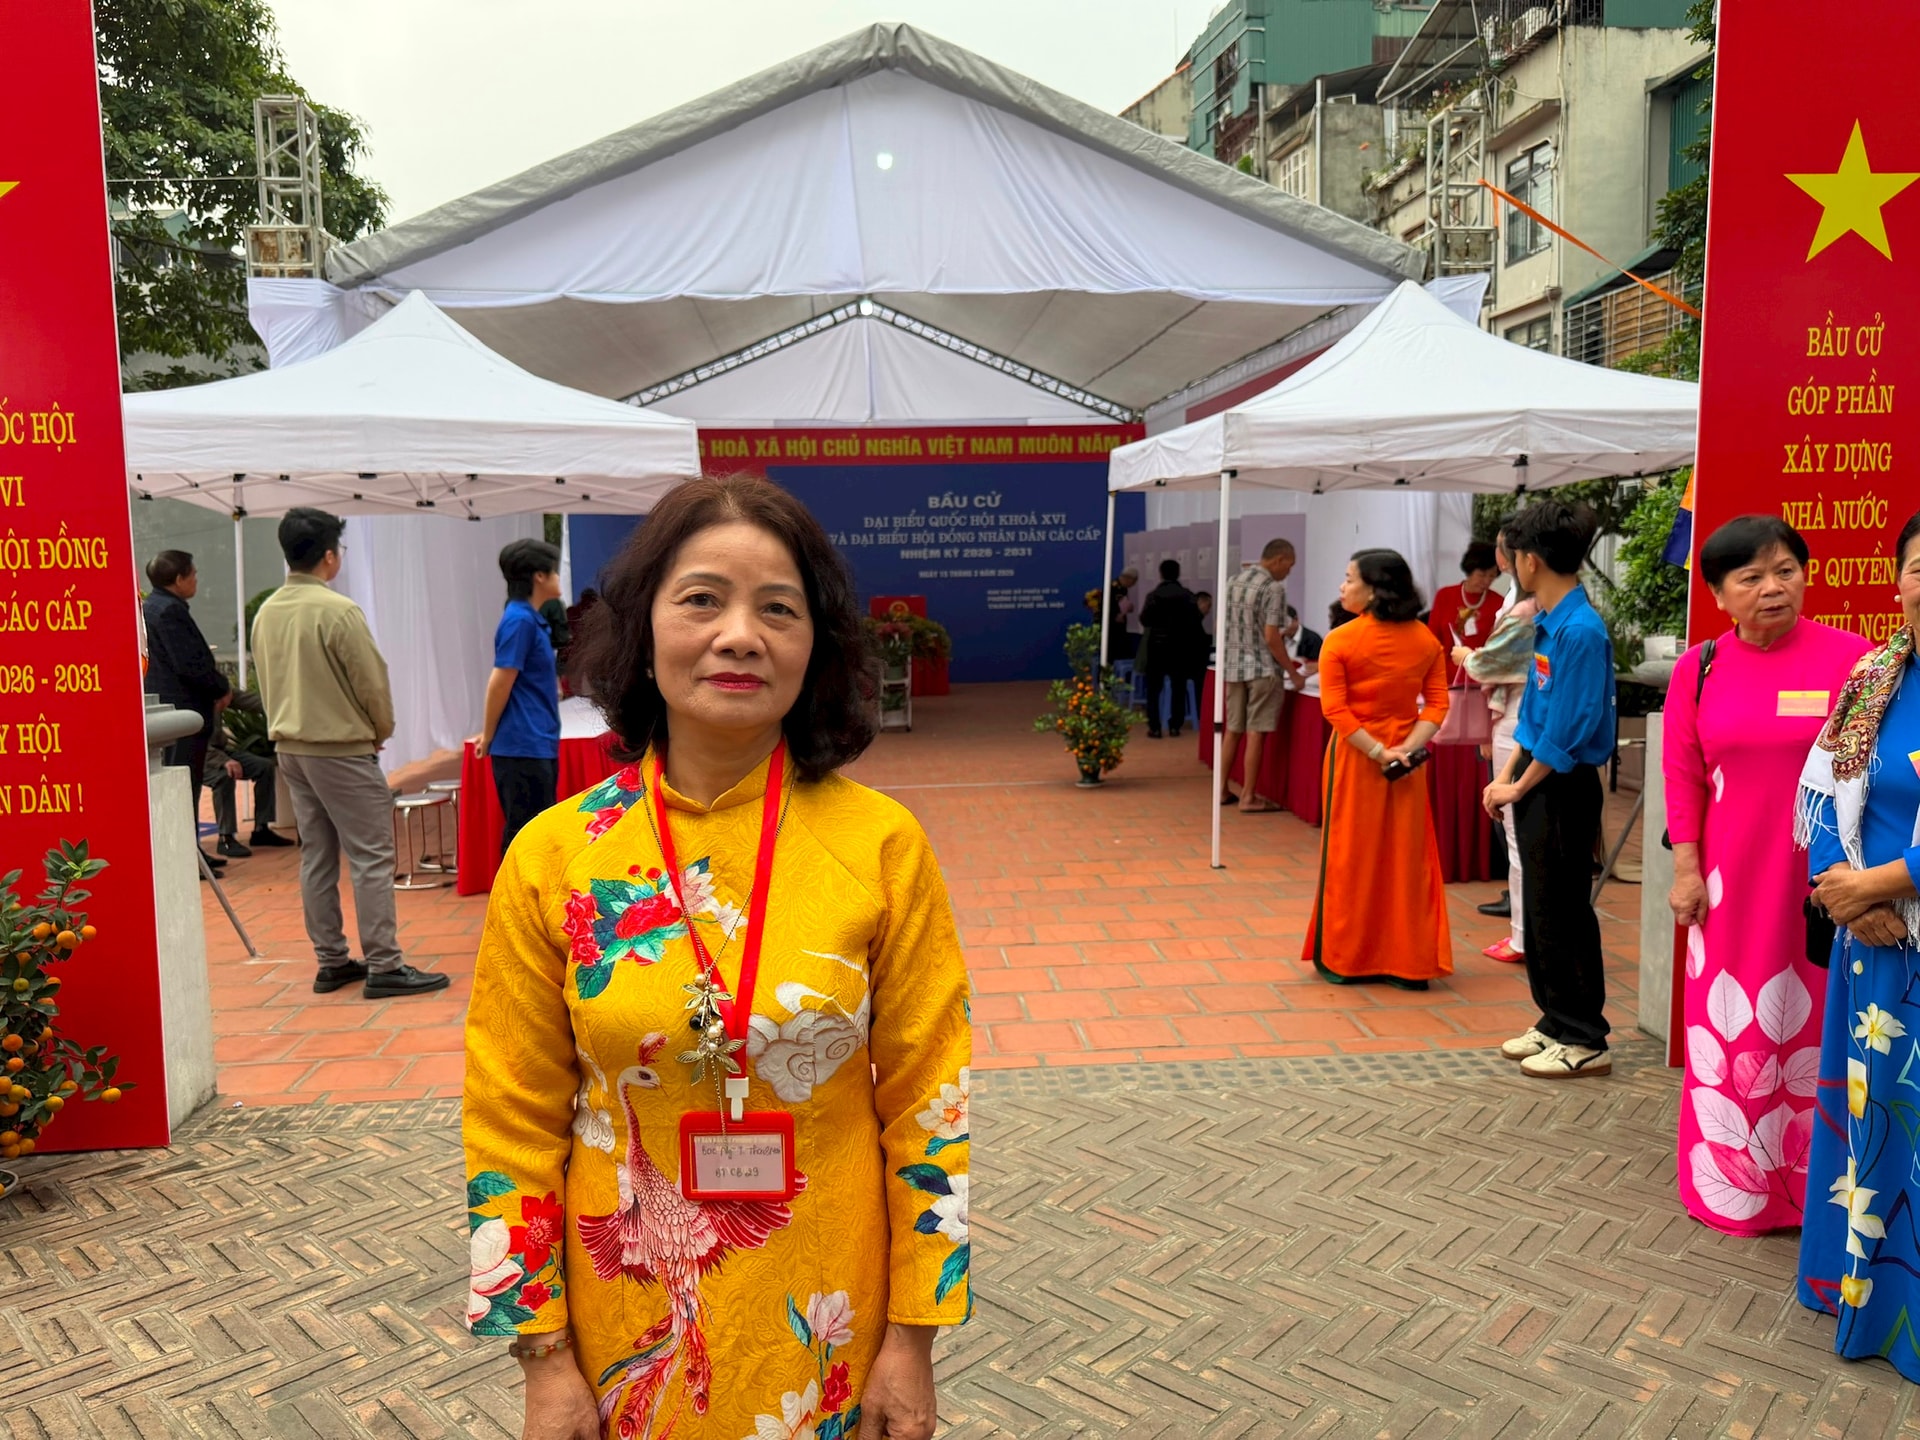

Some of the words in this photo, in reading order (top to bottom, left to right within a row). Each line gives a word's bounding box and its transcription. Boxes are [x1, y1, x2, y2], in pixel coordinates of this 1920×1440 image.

[1806, 310, 1850, 357] BẦU
[1856, 312, 1885, 357] CỬ
[1787, 375, 1831, 416] GÓP
[1835, 367, 1895, 414] PHẦN
[30, 401, 77, 453] HỘI
[711, 436, 749, 457] HOÀ
[755, 435, 780, 457] XÃ
[786, 434, 817, 460] HỘI
[823, 434, 860, 457] CHỦ
[865, 434, 922, 456] NGHĨA
[927, 434, 965, 459] VIỆT
[970, 437, 1013, 455] NAM
[1019, 433, 1073, 454] MUÔN
[1078, 433, 1120, 453] NĂM
[1782, 434, 1829, 474] XÂY
[1834, 438, 1892, 480] DỰNG
[864, 516, 889, 530] ĐẠI
[893, 509, 925, 528] BIỂU
[928, 510, 966, 528] QUỐC
[970, 511, 995, 529] HỘI
[998, 511, 1037, 526] KHOÁ
[1041, 514, 1066, 526] XVI
[928, 490, 968, 509] BẦU
[974, 490, 1002, 508] CỬ
[1781, 492, 1826, 530] NHÀ
[1831, 490, 1888, 529] NƯỚC
[0, 528, 32, 579] ỘI
[37, 520, 109, 569] ĐỒNG
[829, 531, 848, 546] VÀ
[850, 533, 875, 548] ĐẠI
[878, 528, 908, 545] BIỂU
[912, 530, 935, 547] HỘI
[938, 528, 976, 544] ĐỒNG
[978, 528, 1016, 543] NHÂN
[1018, 528, 1047, 542] DÂN
[1049, 527, 1074, 542] CÁC
[1076, 525, 1101, 541] CẤP
[900, 547, 941, 561] NHIỆM
[944, 547, 960, 559] KỲ
[963, 548, 993, 559] 2026
[1004, 547, 1032, 557] 2031
[1825, 540, 1897, 588] QUYỀN
[45, 584, 93, 632] CẤP
[1858, 613, 1907, 642] NGH
[54, 663, 102, 693] 2031
[16, 713, 62, 763] HỘI
[19, 773, 71, 814] DÂN
